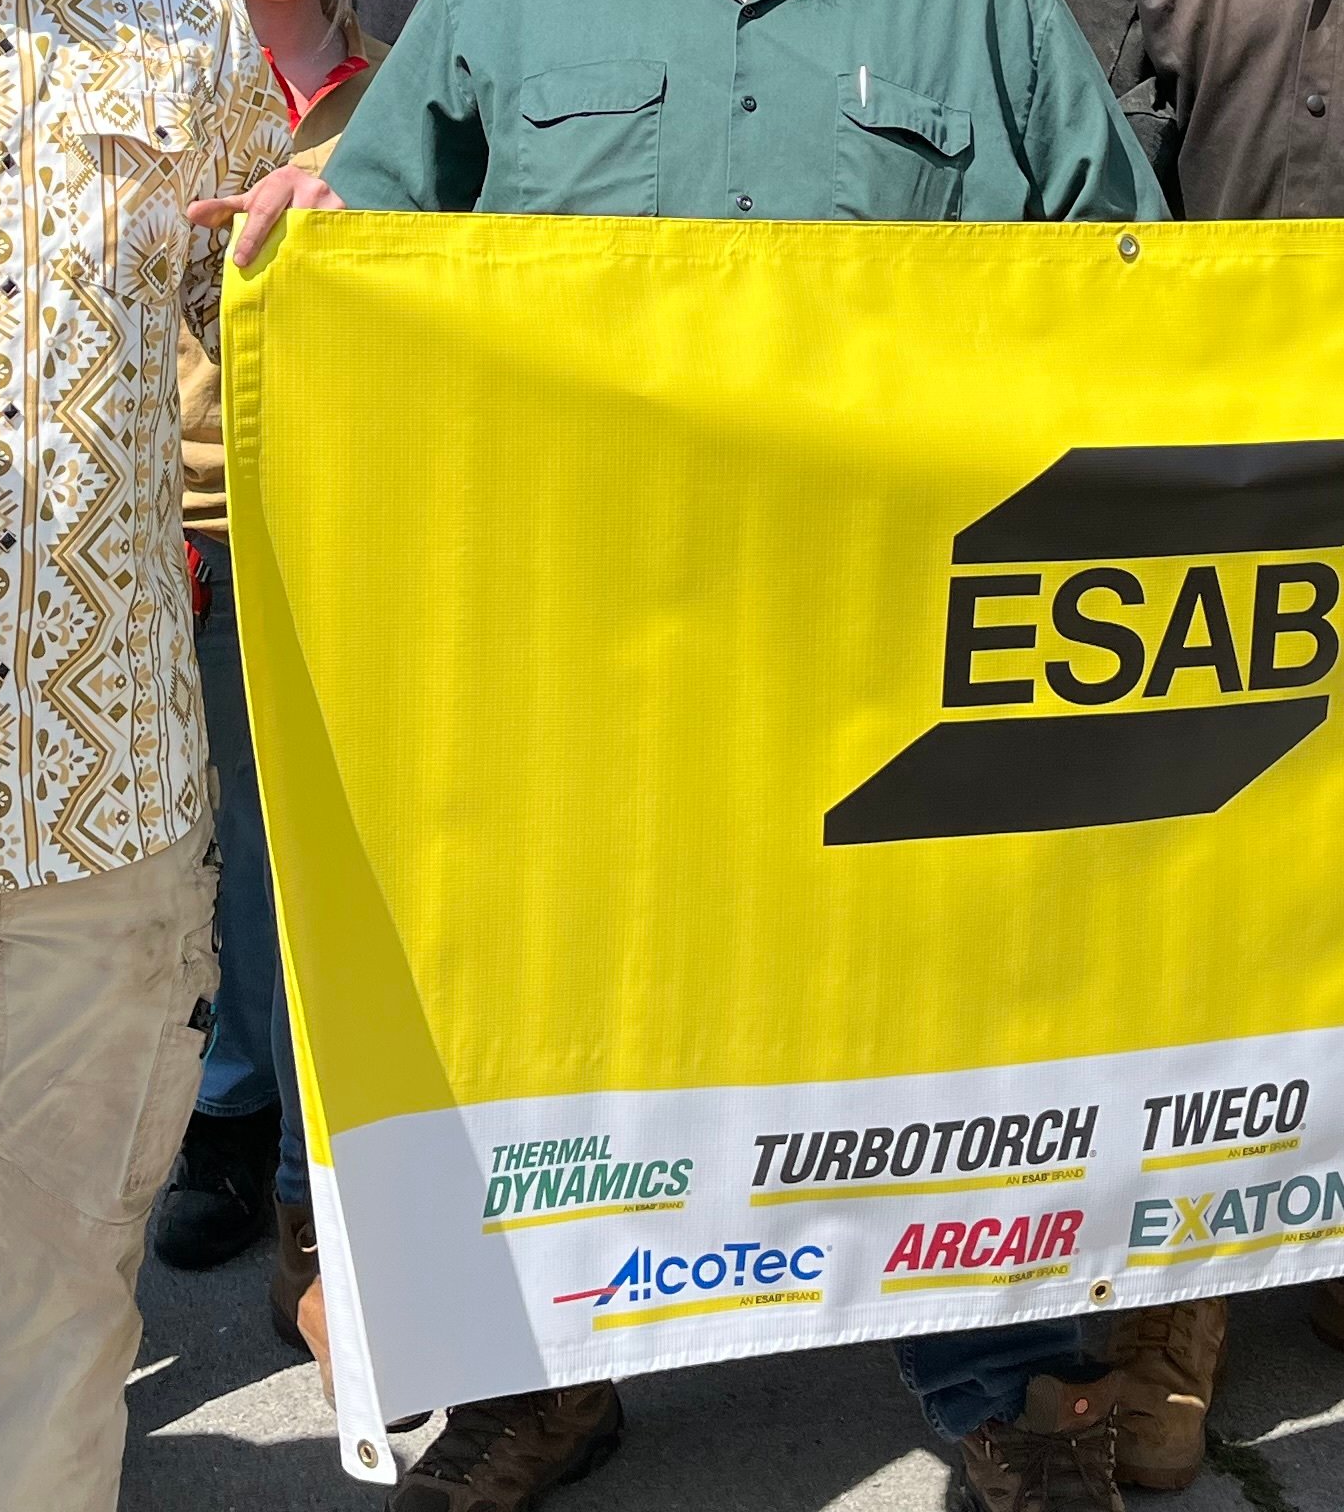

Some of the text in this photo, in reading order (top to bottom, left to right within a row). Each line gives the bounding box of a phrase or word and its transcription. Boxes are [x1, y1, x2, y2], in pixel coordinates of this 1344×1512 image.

[941, 560, 1341, 708] ESAB
[1142, 1078, 1310, 1151] TWECO
[492, 1135, 612, 1174] THERMAL
[751, 1105, 1099, 1186] TURBOTORCH
[1227, 1139, 1298, 1159] AN ESAB BRAND
[483, 1158, 694, 1218] DYNAMICS
[1006, 1169, 1084, 1185] AN ESAB BRAND
[883, 1209, 1084, 1273] ARCAIR
[1283, 1233, 1298, 1242] AN
[992, 1265, 1069, 1284] AN ESAB BRAND
[739, 1291, 820, 1306] AN ESAB BRAND
